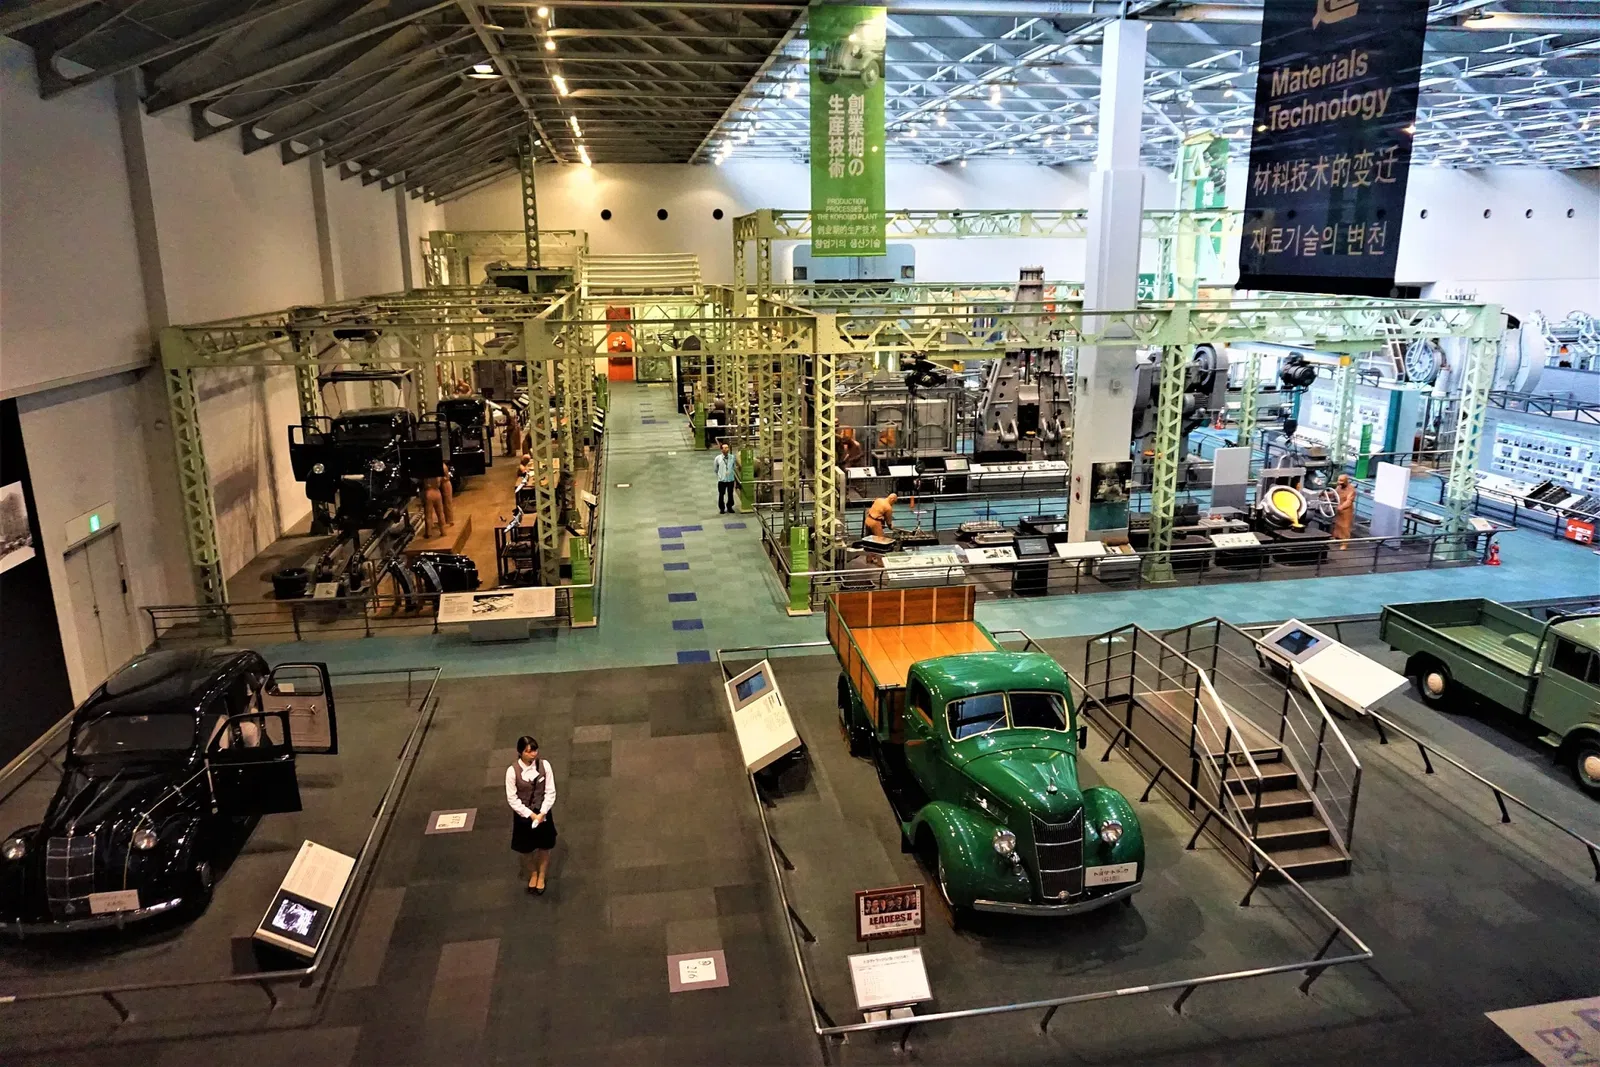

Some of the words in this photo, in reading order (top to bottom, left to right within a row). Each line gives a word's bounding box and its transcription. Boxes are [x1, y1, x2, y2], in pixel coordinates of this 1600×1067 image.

[1271, 49, 1368, 97] Materials
[1269, 87, 1392, 131] Technology
[828, 94, 845, 178] 生産技術
[848, 94, 864, 177] 創業期の
[1254, 144, 1399, 197] 材料技术的变迁
[1250, 223, 1338, 257] 재료기술의
[1348, 221, 1387, 256] 변천
[869, 913, 907, 926] LEADERS
